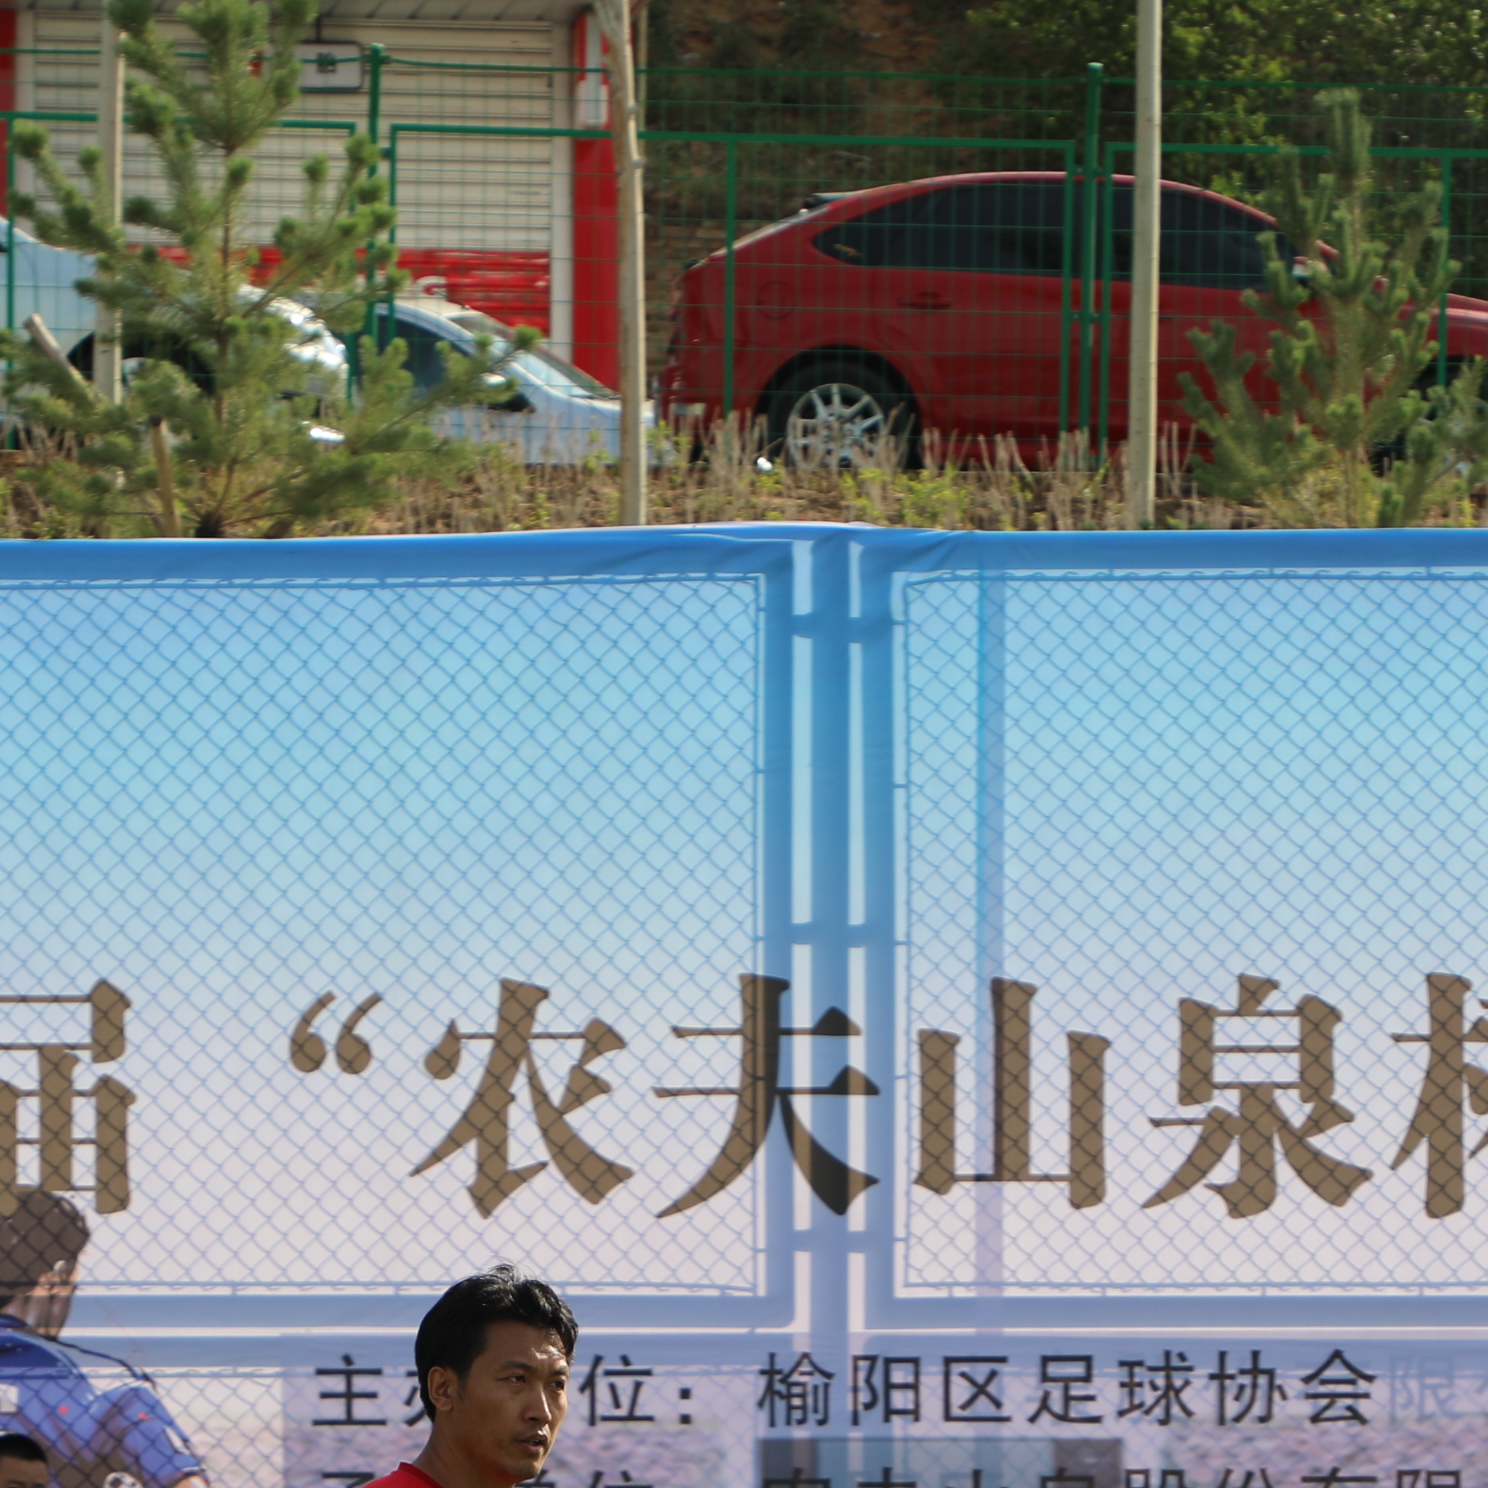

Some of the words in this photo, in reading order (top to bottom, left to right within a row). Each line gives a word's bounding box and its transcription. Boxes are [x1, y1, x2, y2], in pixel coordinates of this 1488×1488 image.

[312, 1349, 1377, 1427] 主位：榆阳区足球协会
